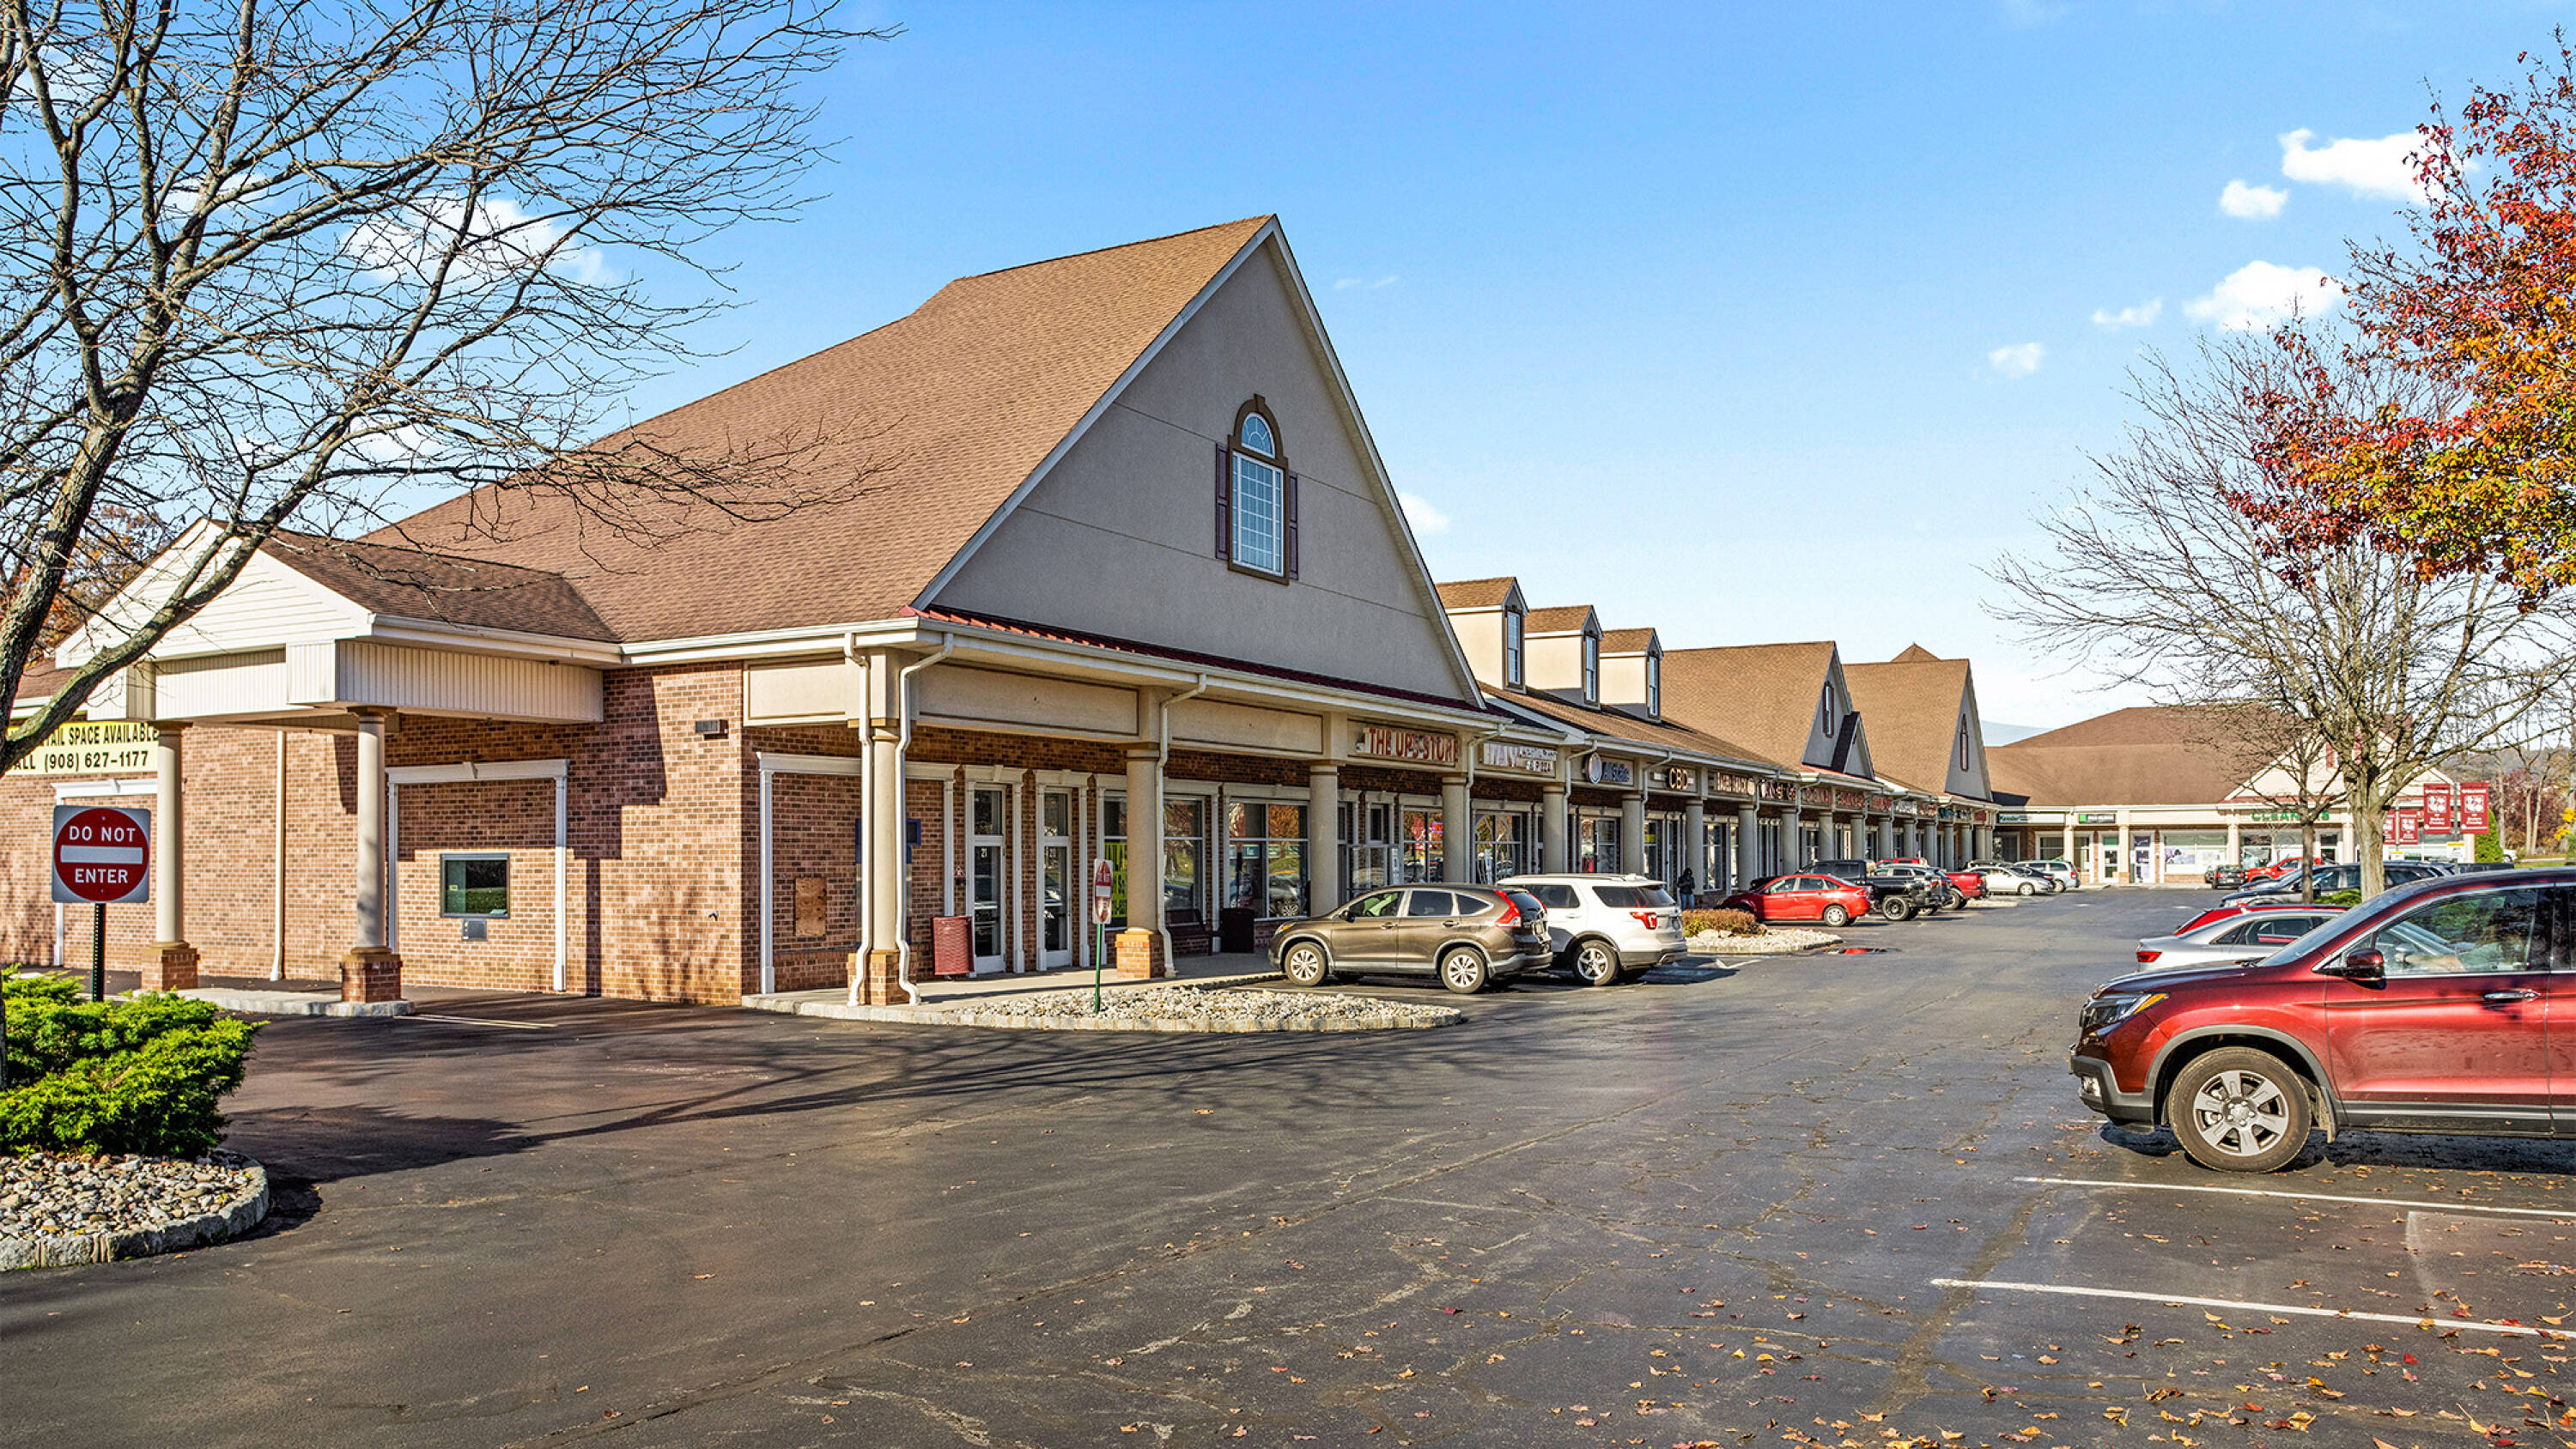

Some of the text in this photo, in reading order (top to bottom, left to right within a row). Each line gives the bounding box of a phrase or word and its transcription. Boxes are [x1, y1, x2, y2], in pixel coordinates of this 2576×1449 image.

[69, 725, 100, 745] SPACE
[103, 723, 159, 744] AVAILABLE
[1370, 727, 1458, 762] THE UPS STORE
[45, 752, 79, 773] (908)
[84, 750, 149, 768] 627-1177
[1668, 767, 1689, 790] CBD
[2251, 810, 2330, 821] CLEANS
[69, 825, 136, 842] DO NOT
[75, 868, 128, 884] ENTER
